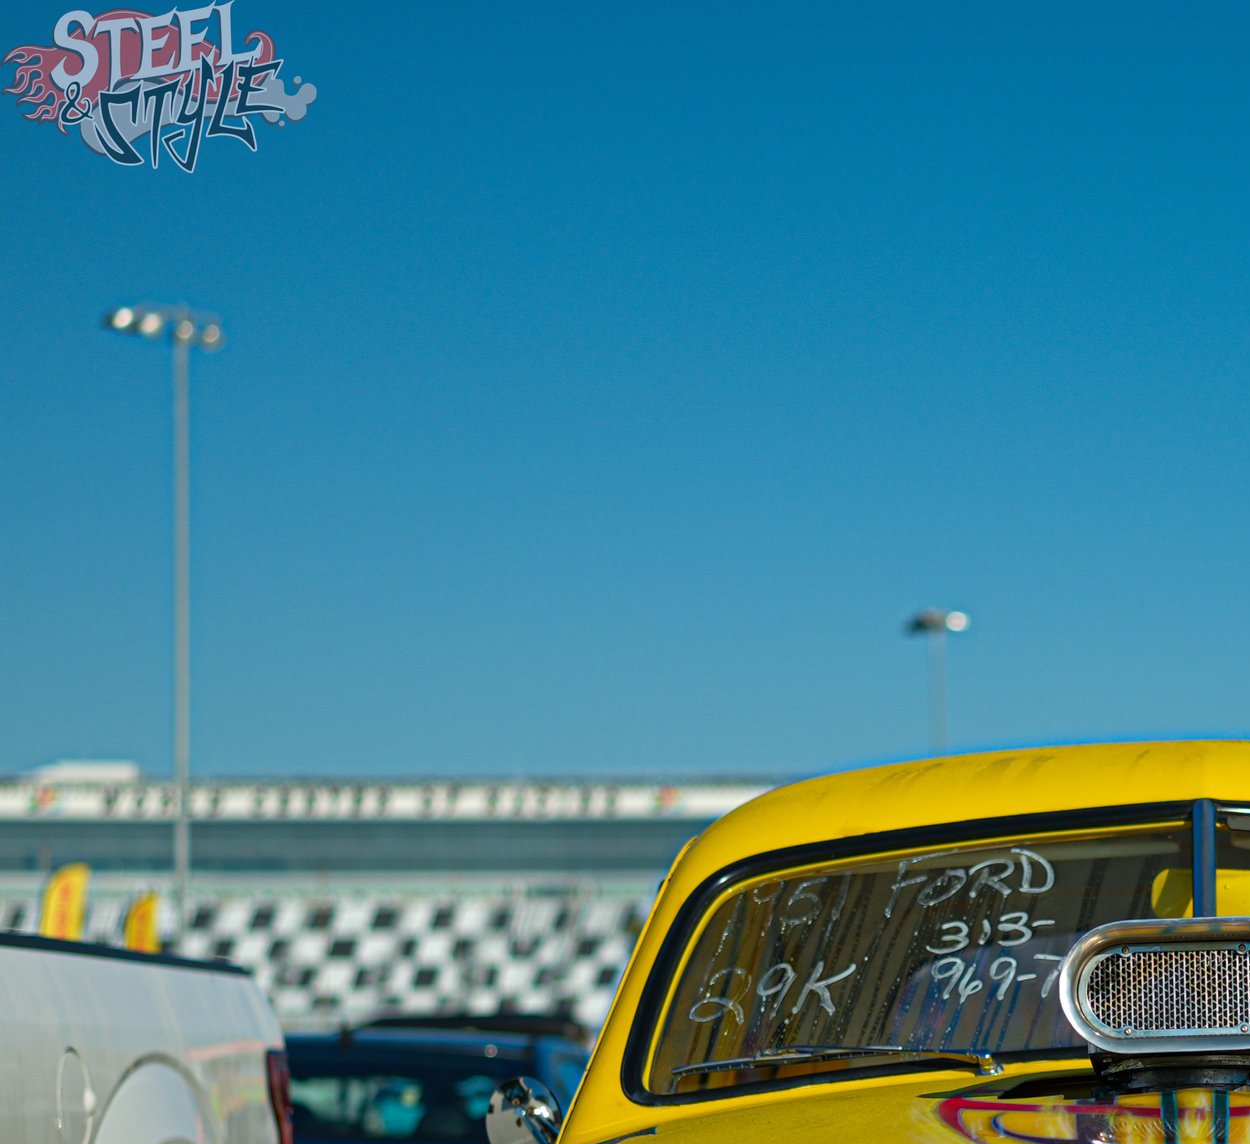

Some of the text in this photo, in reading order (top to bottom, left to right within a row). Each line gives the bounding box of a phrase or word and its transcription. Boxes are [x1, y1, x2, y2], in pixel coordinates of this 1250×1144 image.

[884, 848, 1055, 919] FORD
[926, 912, 1055, 954] 313-
[931, 953, 1067, 1005] 969-7
